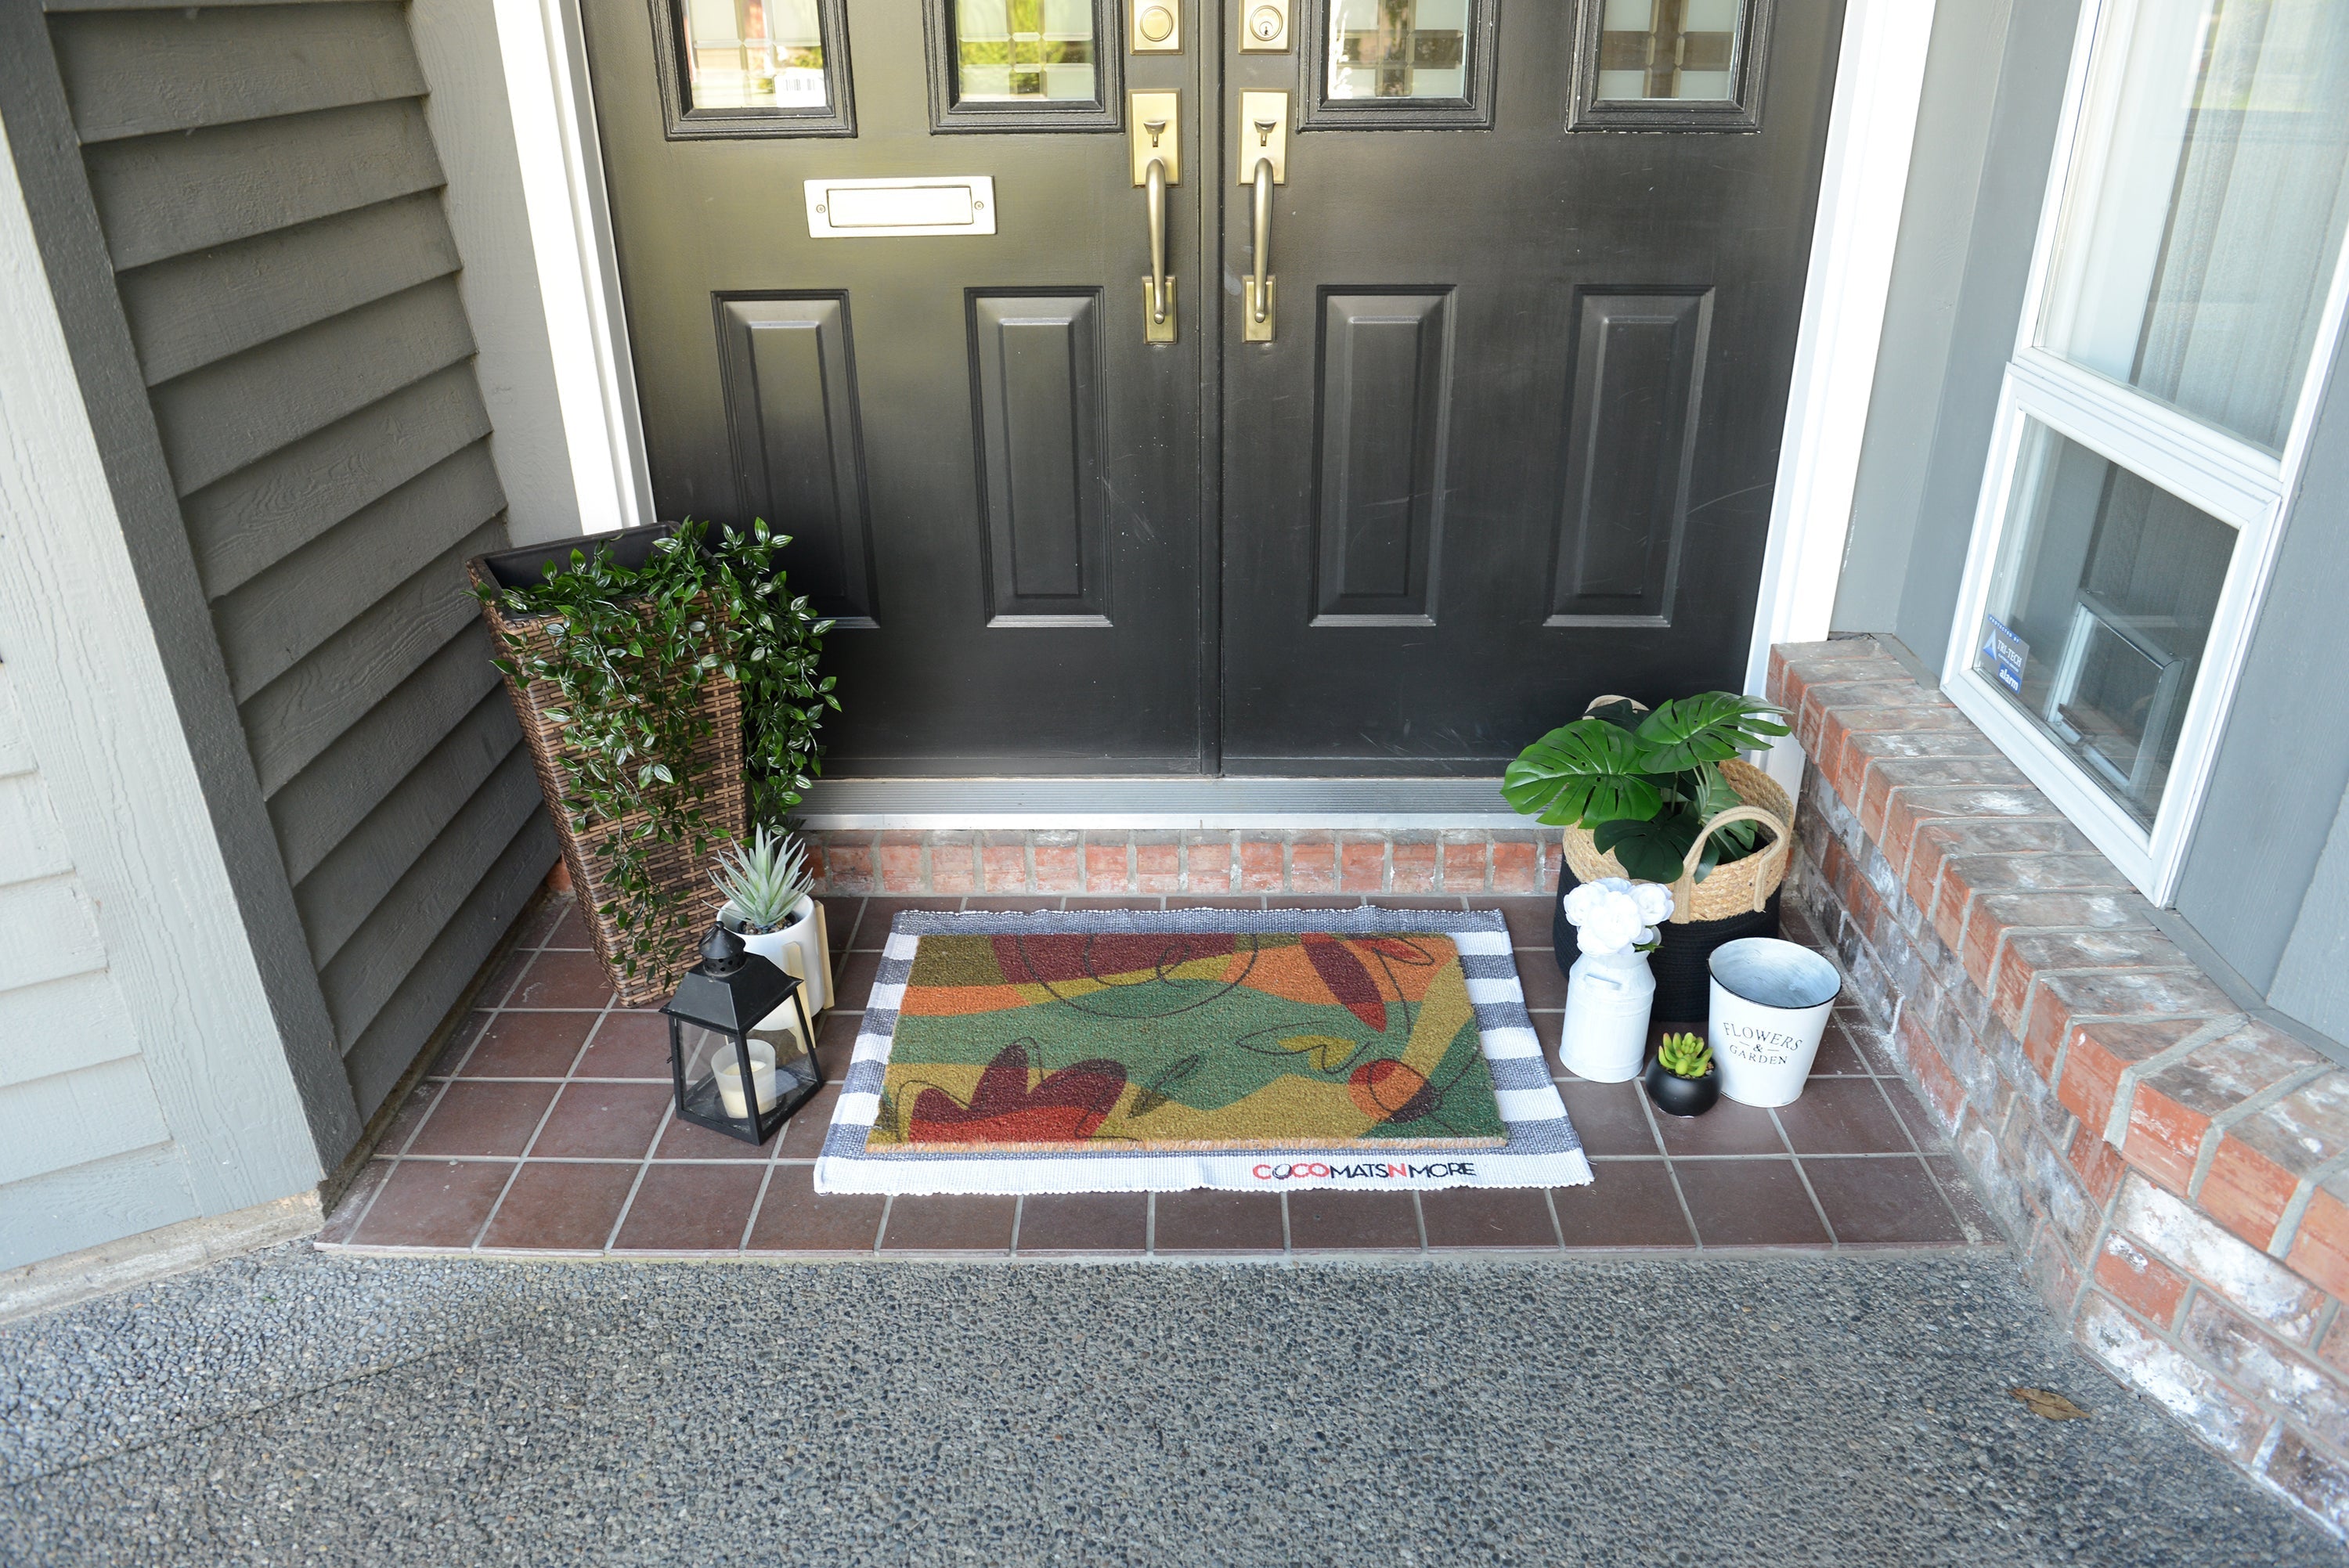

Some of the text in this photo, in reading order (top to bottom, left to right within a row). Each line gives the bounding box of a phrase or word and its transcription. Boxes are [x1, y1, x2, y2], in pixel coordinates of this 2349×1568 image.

[1997, 640, 2022, 667] TRI-TECH
[1999, 669, 2019, 691] alarm
[1723, 1022, 1803, 1051] FLOWERS
[1729, 1044, 1788, 1065] GARDEN
